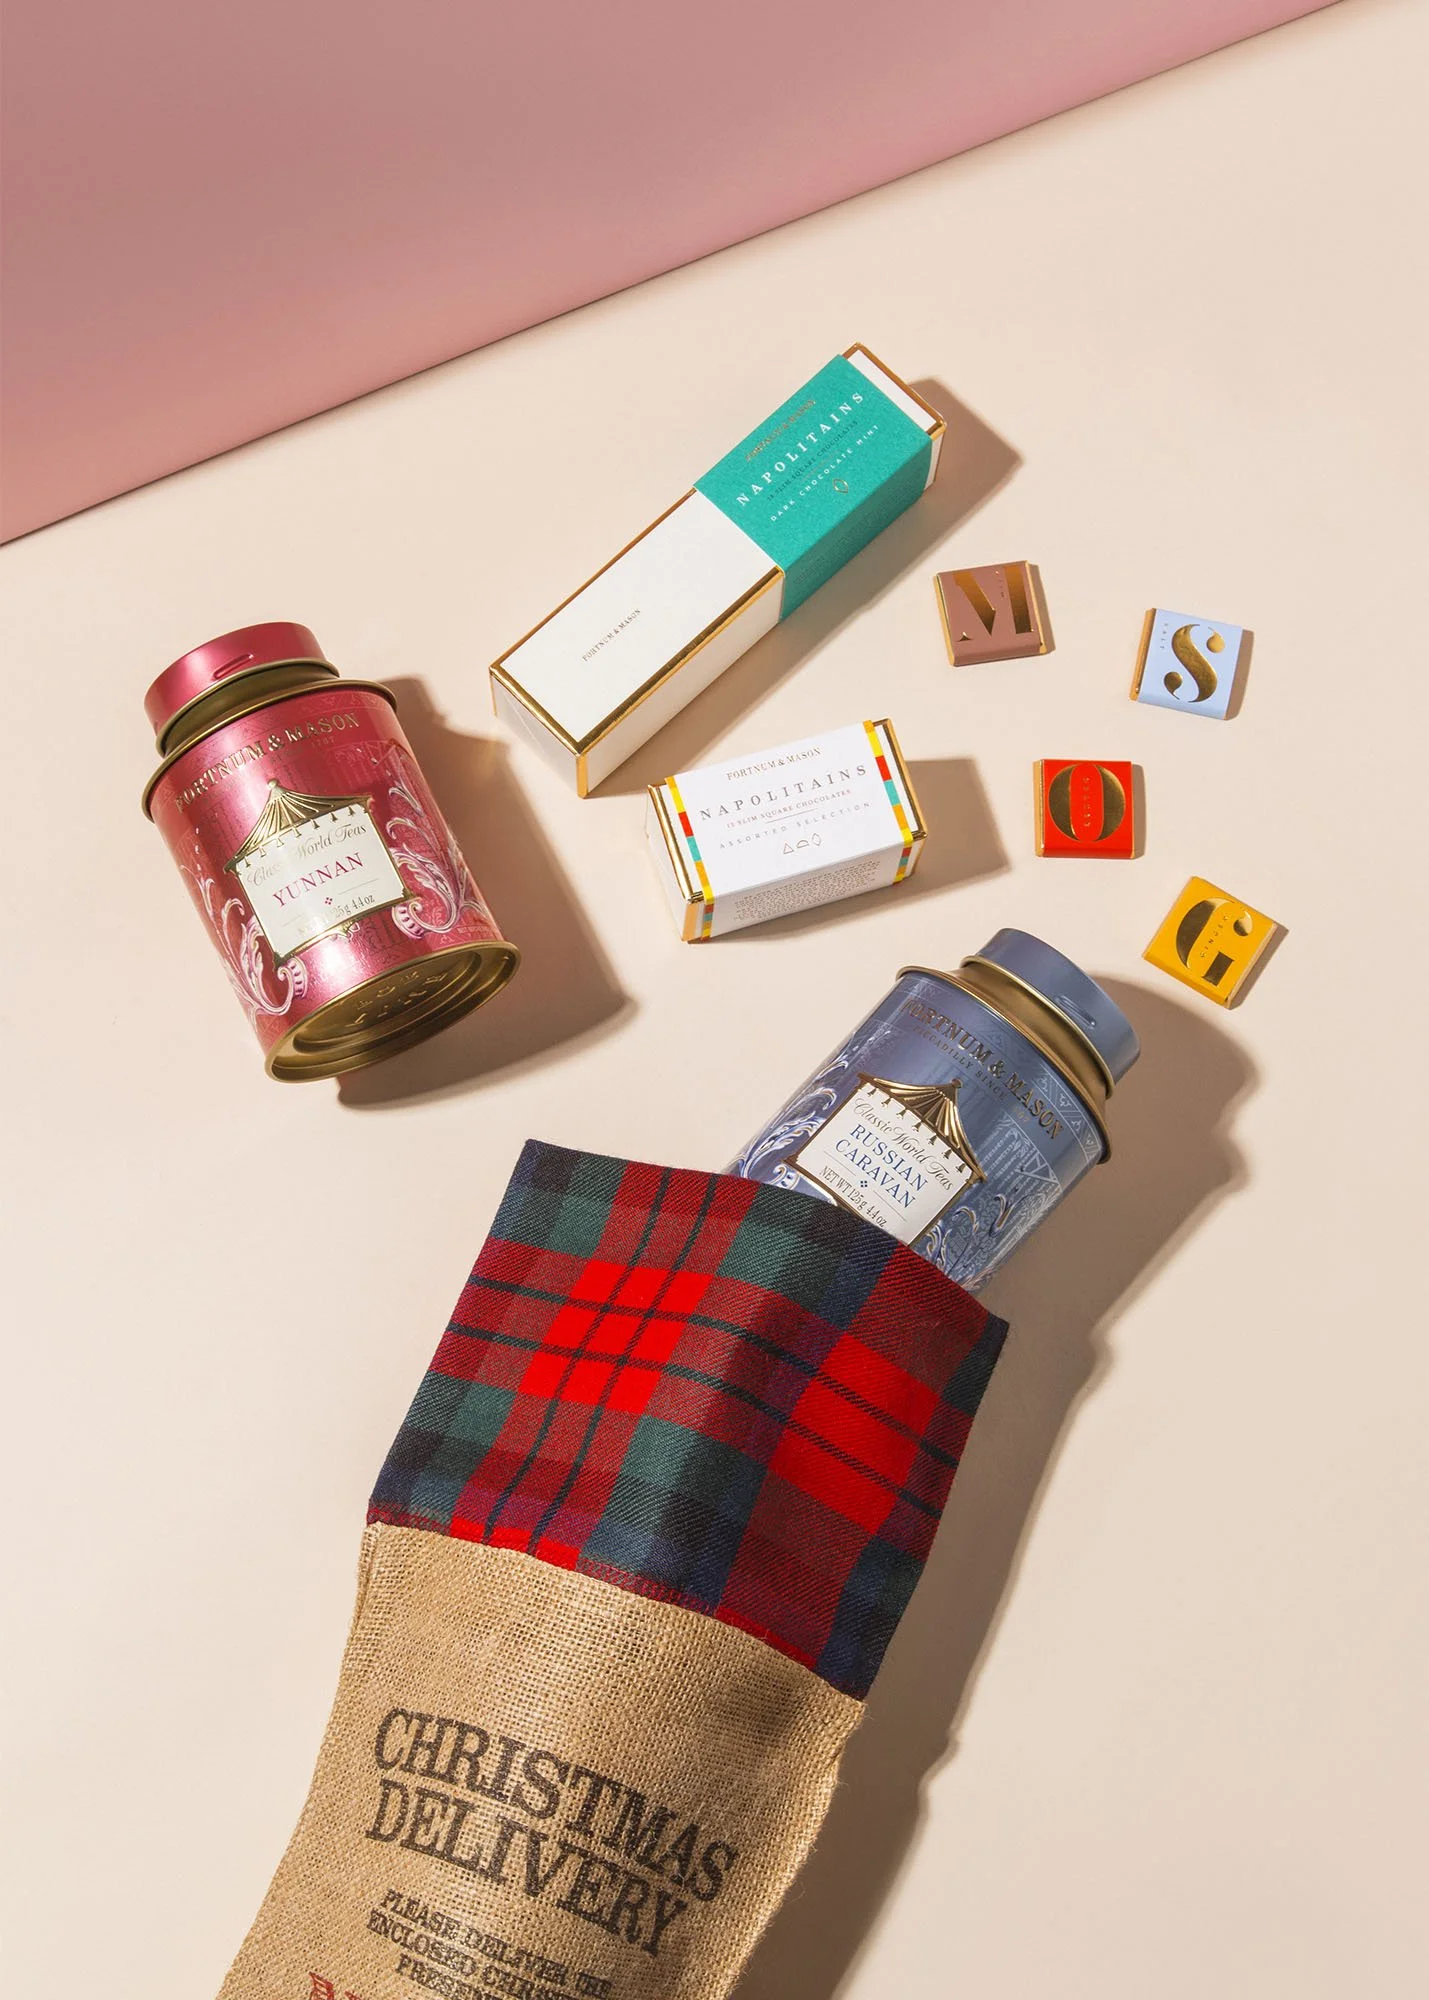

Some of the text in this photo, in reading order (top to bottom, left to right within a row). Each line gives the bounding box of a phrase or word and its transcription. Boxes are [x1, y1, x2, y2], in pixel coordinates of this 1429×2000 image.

[736, 392, 864, 506] NAPOLITAINS
[770, 424, 880, 522] DARK CHOCOLATE MINT
[581, 632, 615, 662] FORTNUM
[618, 608, 641, 630] MASON
[952, 564, 1034, 643] M
[1163, 623, 1226, 703] S
[175, 740, 266, 815] FORTNUM
[267, 733, 286, 752] &
[284, 711, 361, 744] MASON
[699, 764, 868, 821] NAPOLITAINS
[726, 746, 821, 781] FORTNUM & MASON
[719, 801, 872, 850] ASSORTED SELECTION
[760, 804, 794, 821] SQUARE
[795, 788, 853, 811] CHOCOLATES
[1047, 762, 1126, 843] O
[295, 829, 333, 860] World
[333, 823, 368, 844] Teas
[272, 851, 364, 908] YUNNAN
[1176, 897, 1253, 987] G
[901, 999, 1064, 1140] FORTNUM & MASON
[911, 1025, 974, 1071] PICCADILLY
[819, 1165, 841, 1187] NET
[837, 1176, 853, 1194] WT
[835, 1138, 916, 1209] CARAVAN
[850, 1124, 928, 1192] RUSSIAN
[853, 1098, 955, 1192] Classic World Teas
[373, 1707, 740, 1902] CHRISTMAS
[365, 1777, 689, 1958] DELIVERY
[366, 1907, 476, 1977] ENCLOSED
[379, 1887, 463, 1943] PLEASE
[463, 1931, 568, 1986] DELIVER
